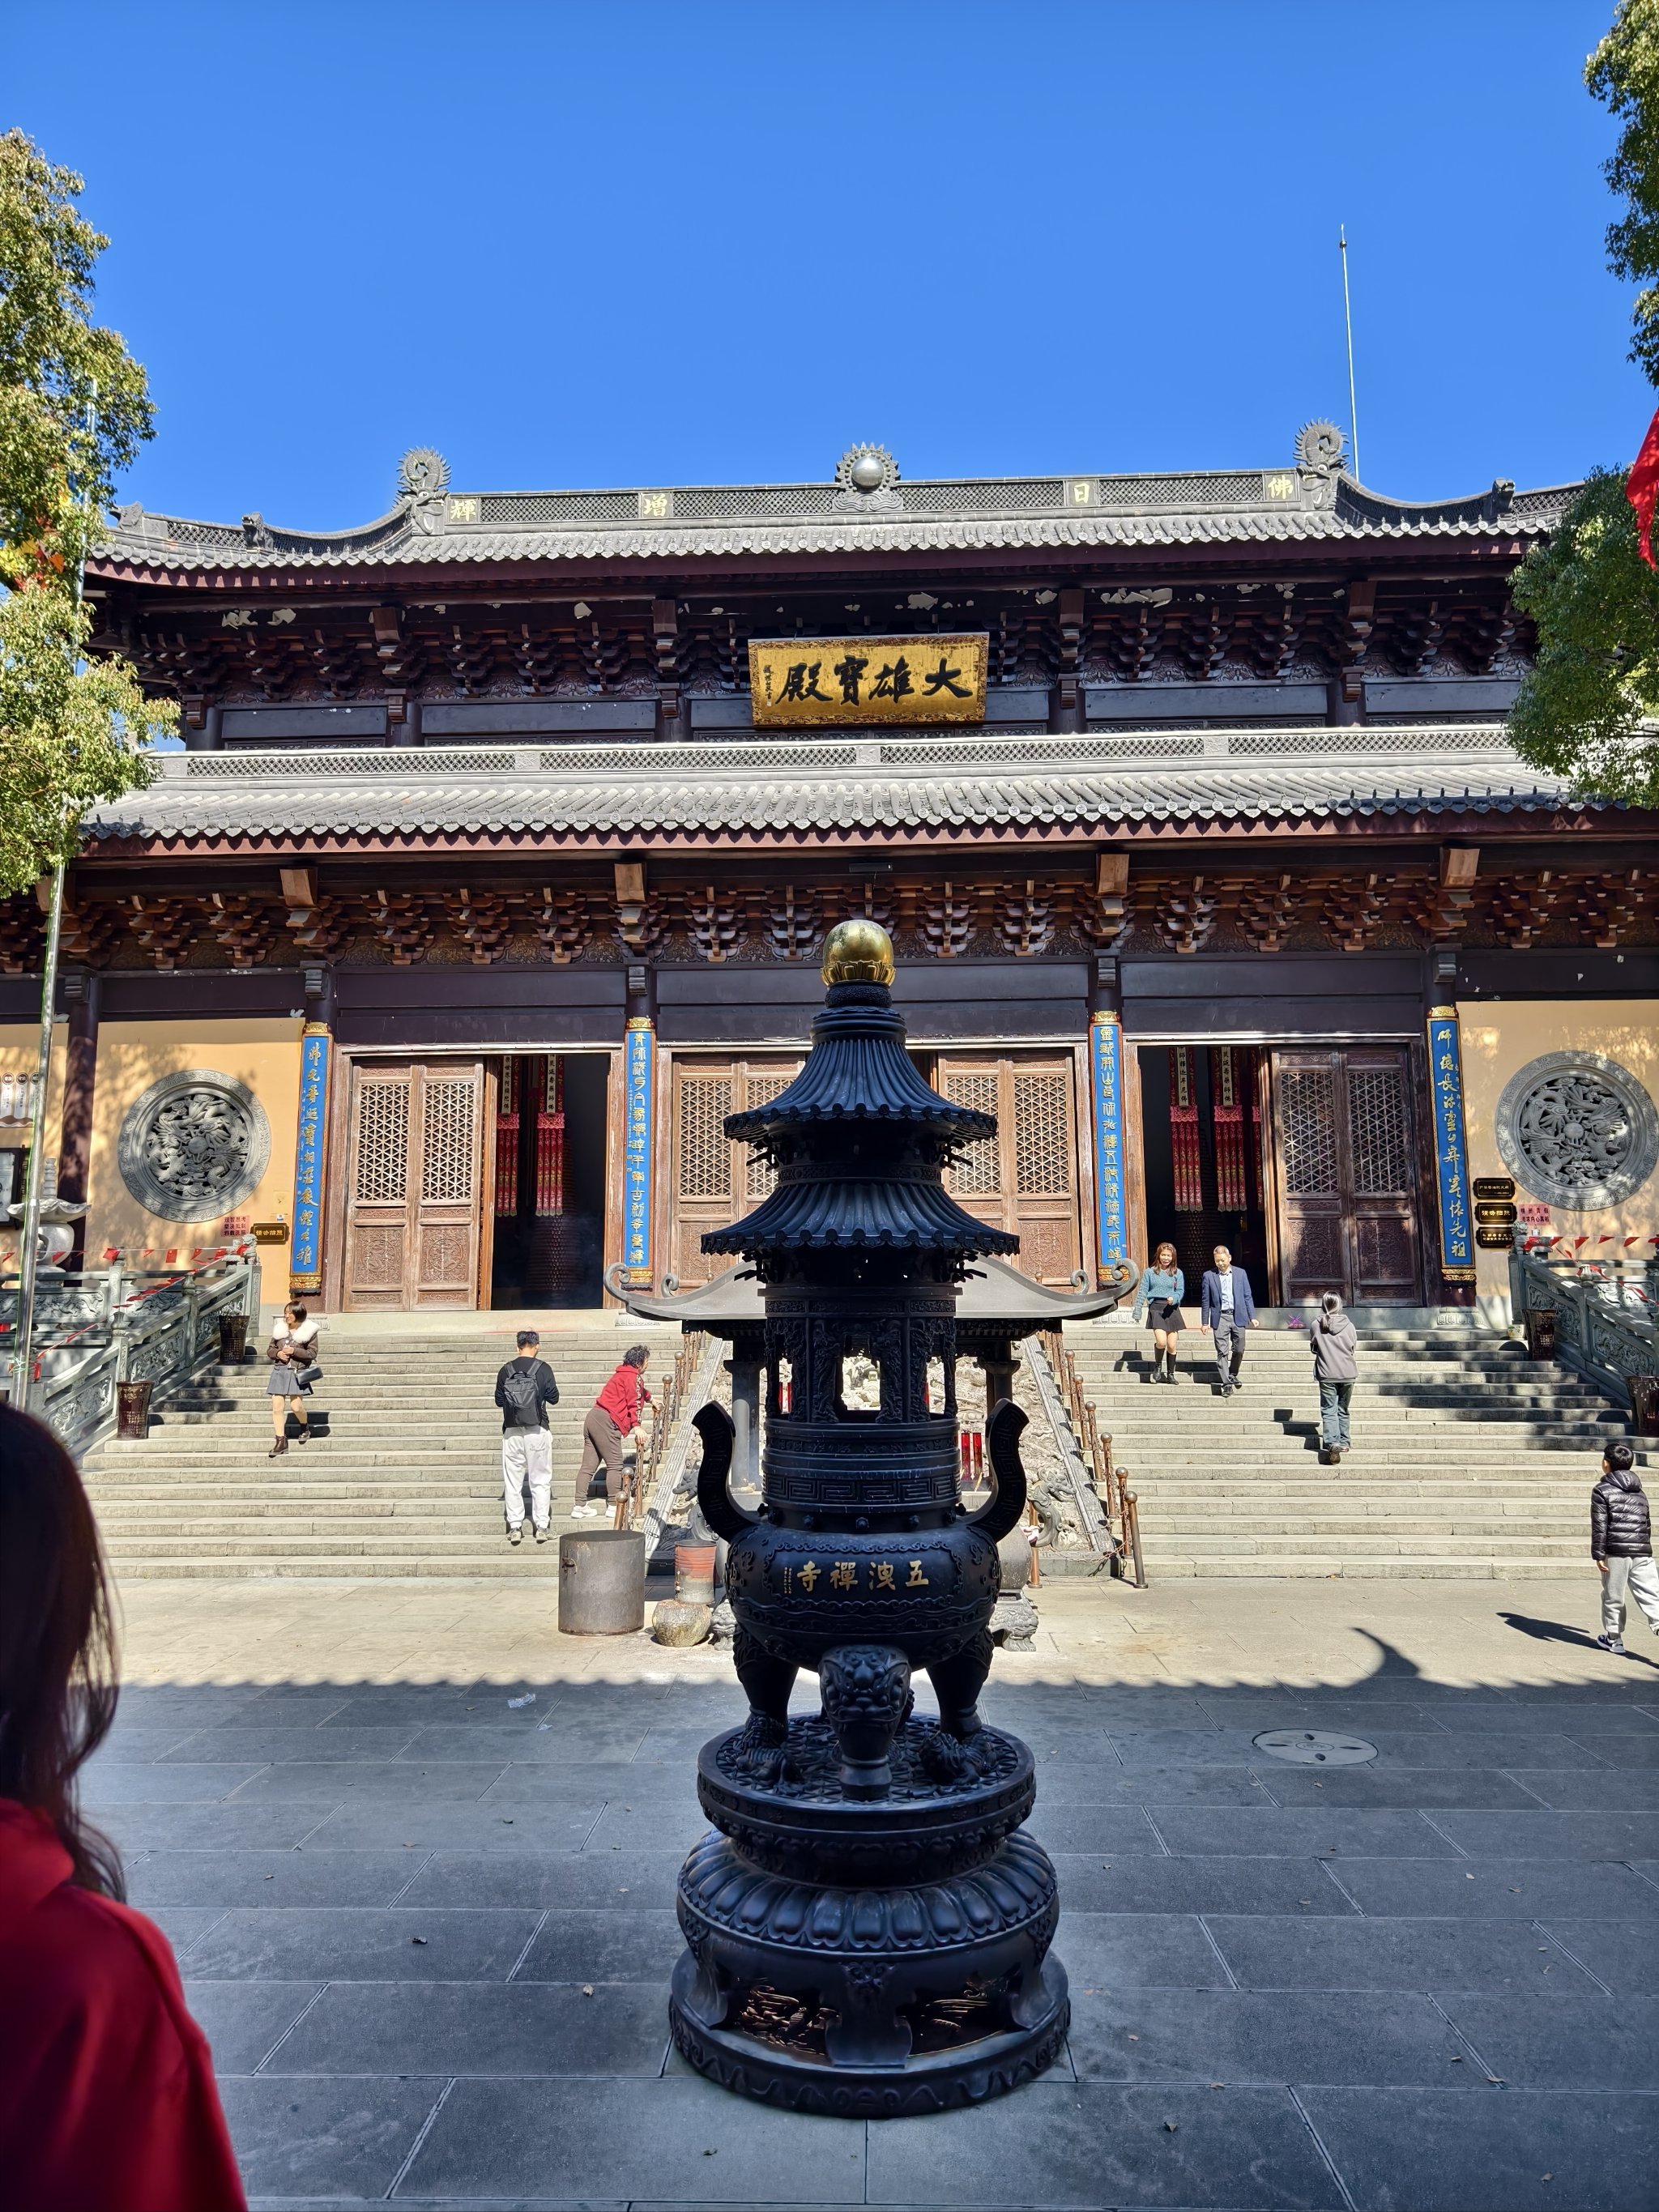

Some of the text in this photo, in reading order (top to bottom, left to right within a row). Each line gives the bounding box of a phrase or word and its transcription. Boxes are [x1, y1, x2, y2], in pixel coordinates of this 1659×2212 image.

[450, 475, 1294, 522] 佛 日 增 輝
[774, 654, 975, 707] 大雄寶殿
[796, 1560, 929, 1592] 五洩禪寺
